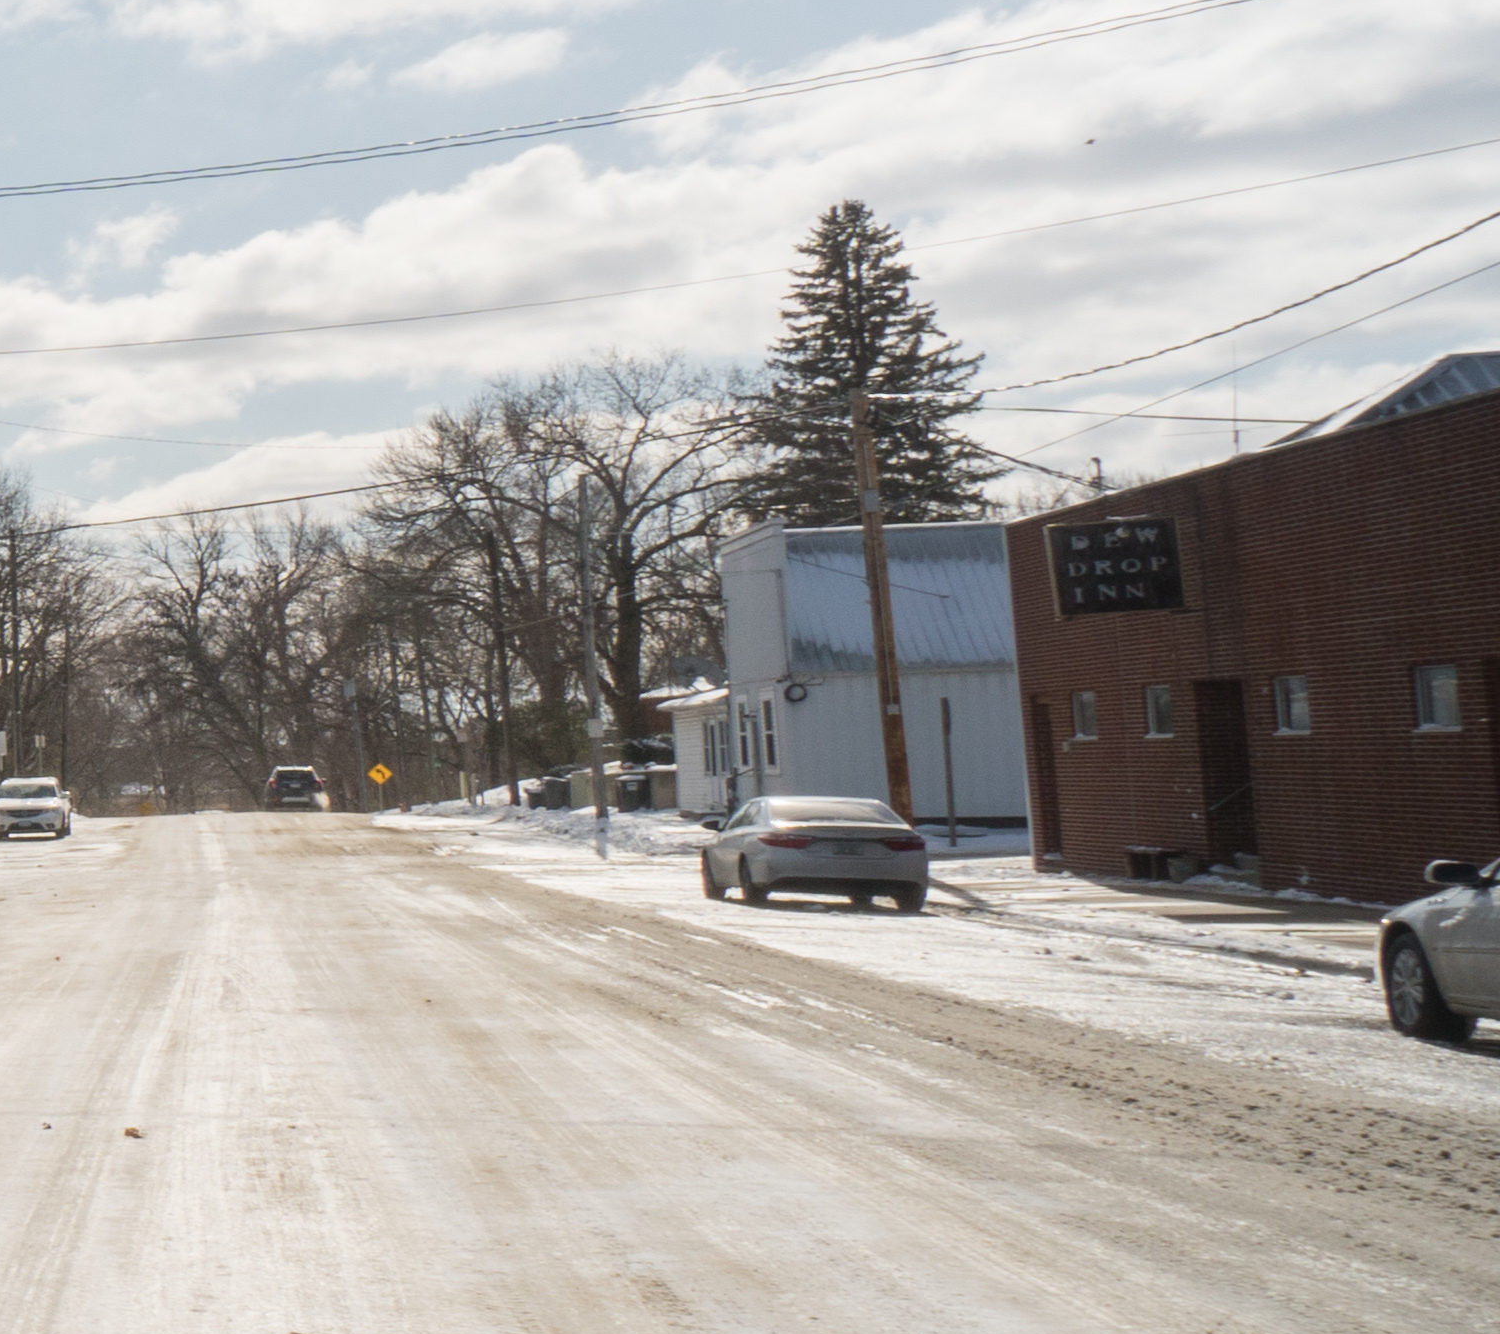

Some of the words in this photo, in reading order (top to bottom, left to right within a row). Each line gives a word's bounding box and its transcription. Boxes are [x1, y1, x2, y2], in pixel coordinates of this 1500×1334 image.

[1070, 527, 1158, 550] DEW
[1067, 556, 1167, 577] DROP
[1074, 582, 1145, 604] INN
